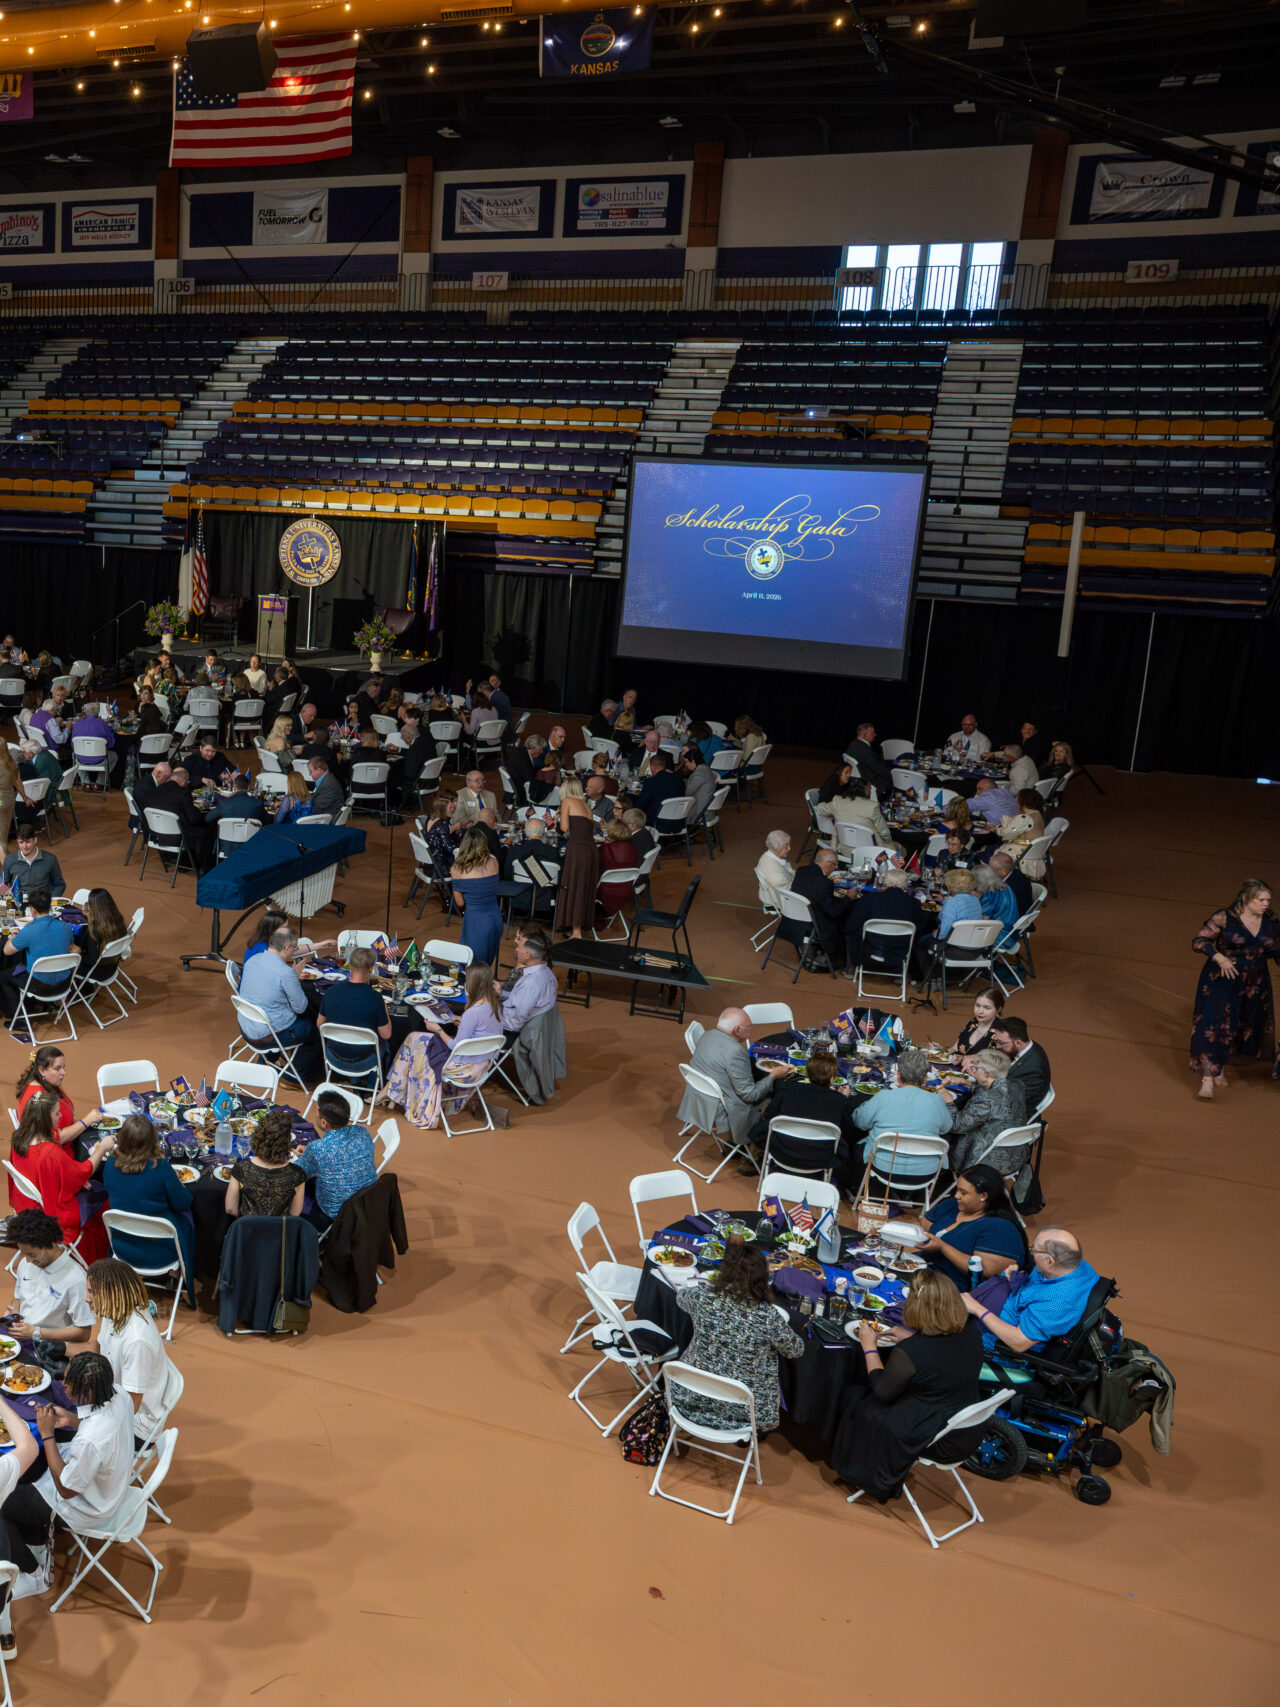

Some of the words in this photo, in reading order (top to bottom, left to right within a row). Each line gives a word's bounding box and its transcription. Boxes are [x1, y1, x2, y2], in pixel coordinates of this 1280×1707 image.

[570, 60, 620, 75] KANSAS
[1141, 174, 1189, 185] Crown
[600, 187, 664, 202] salinablue
[485, 198, 524, 208] KANSAS
[258, 209, 277, 217] FUEL
[74, 218, 109, 226] AMERICAN
[110, 217, 137, 225] FAMILY
[258, 216, 307, 225] TOMORROW
[841, 270, 874, 284] 108
[1133, 264, 1170, 278] 109
[168, 280, 190, 292] 106
[478, 275, 503, 288] 107
[664, 494, 811, 541] Scholarship
[788, 504, 880, 548] Gala
[289, 521, 336, 542] UNIVERSITAS
[742, 592, 758, 600] April
[766, 593, 783, 601] 2026
